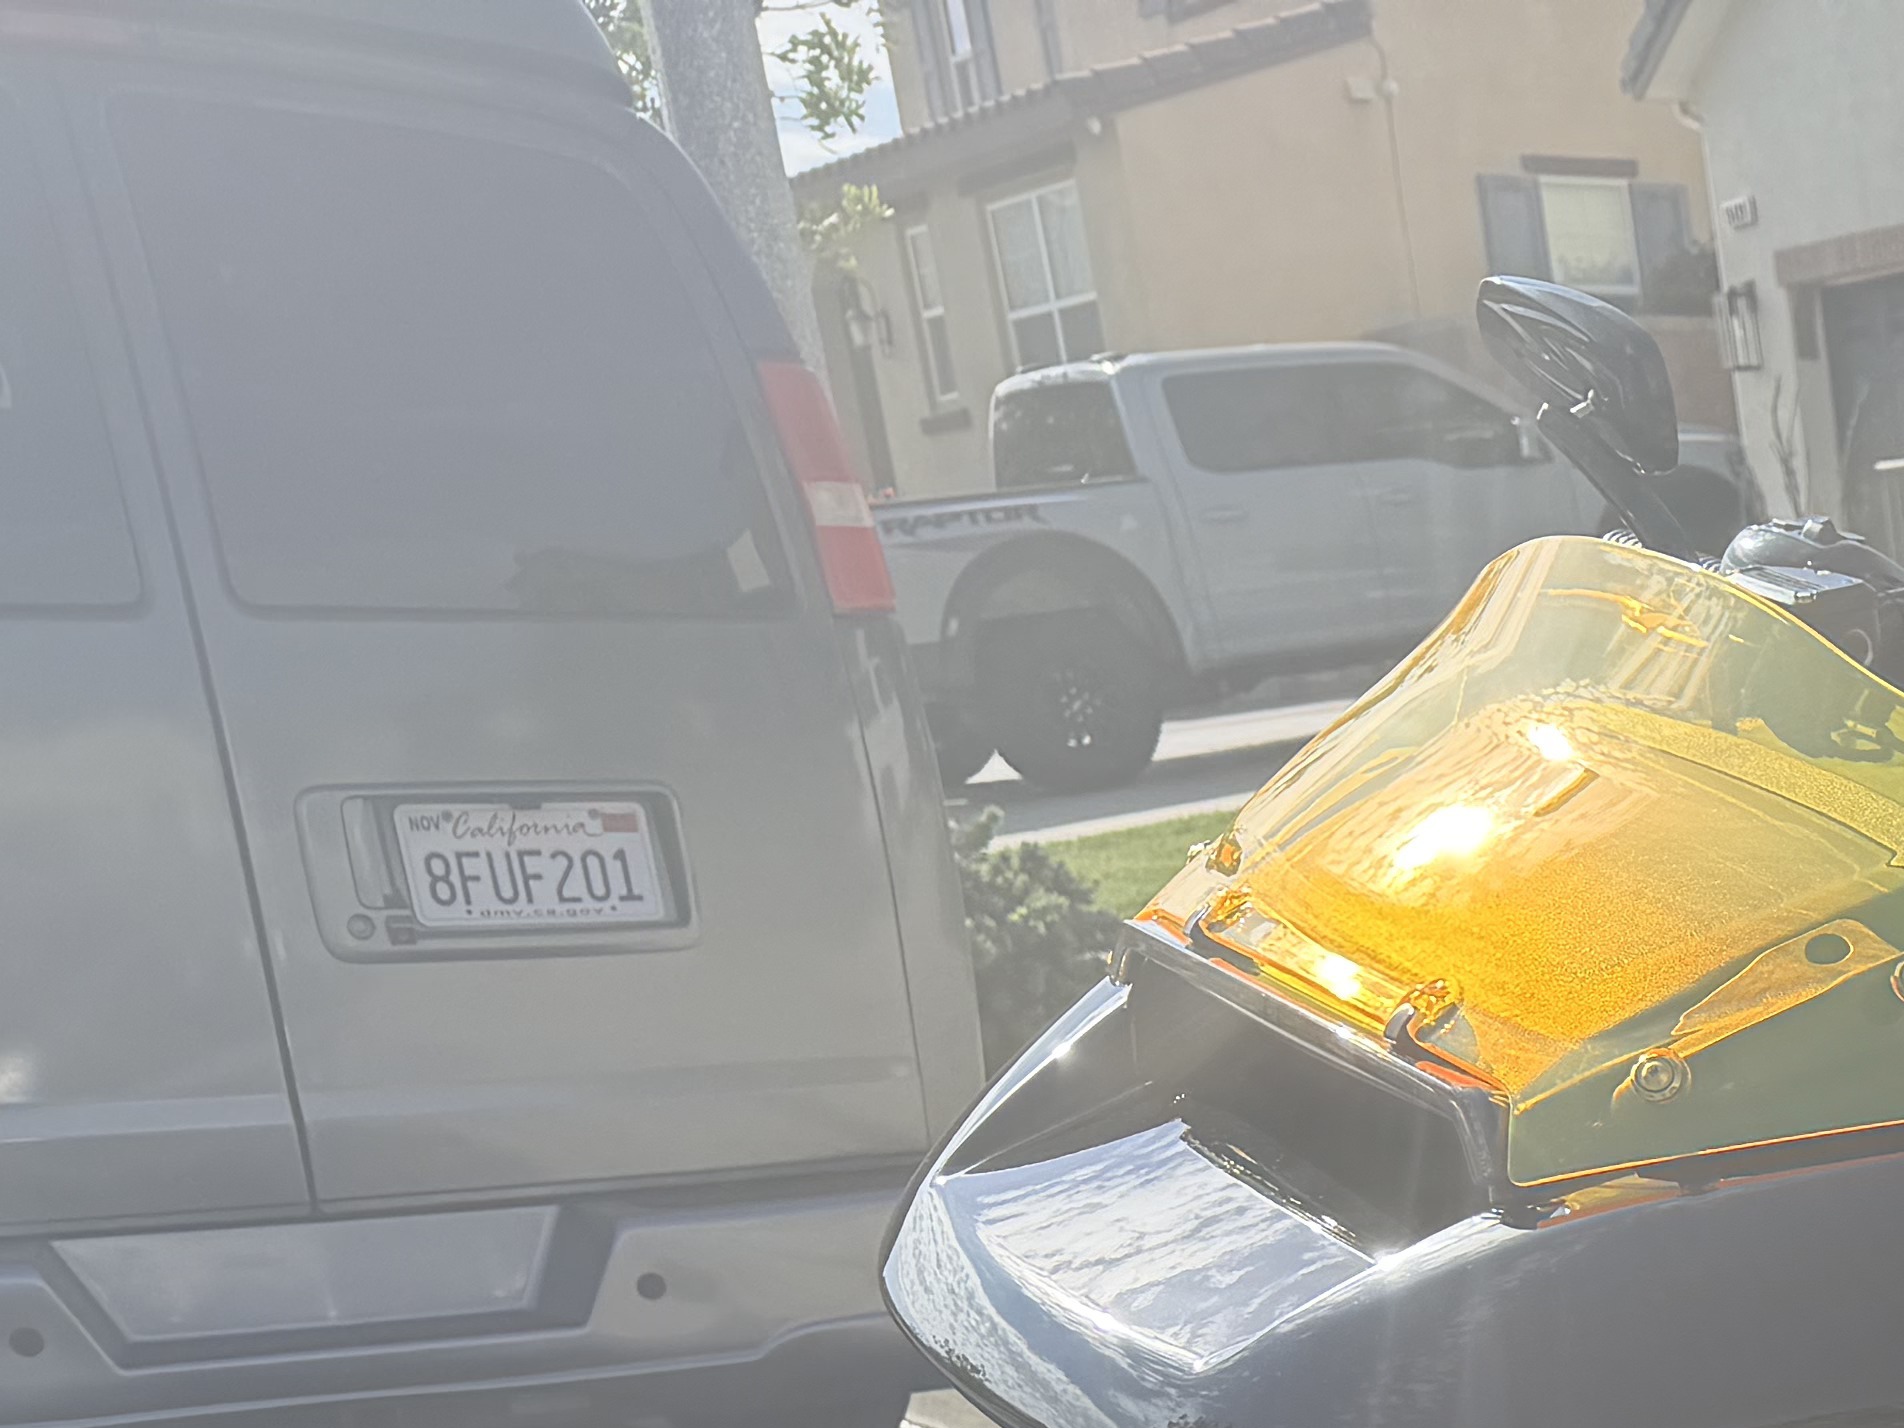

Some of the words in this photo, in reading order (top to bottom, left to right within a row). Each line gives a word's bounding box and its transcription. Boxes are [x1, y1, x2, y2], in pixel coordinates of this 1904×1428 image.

[408, 815, 441, 832] NOV
[452, 811, 604, 847] California
[424, 848, 644, 906] 8FUF201
